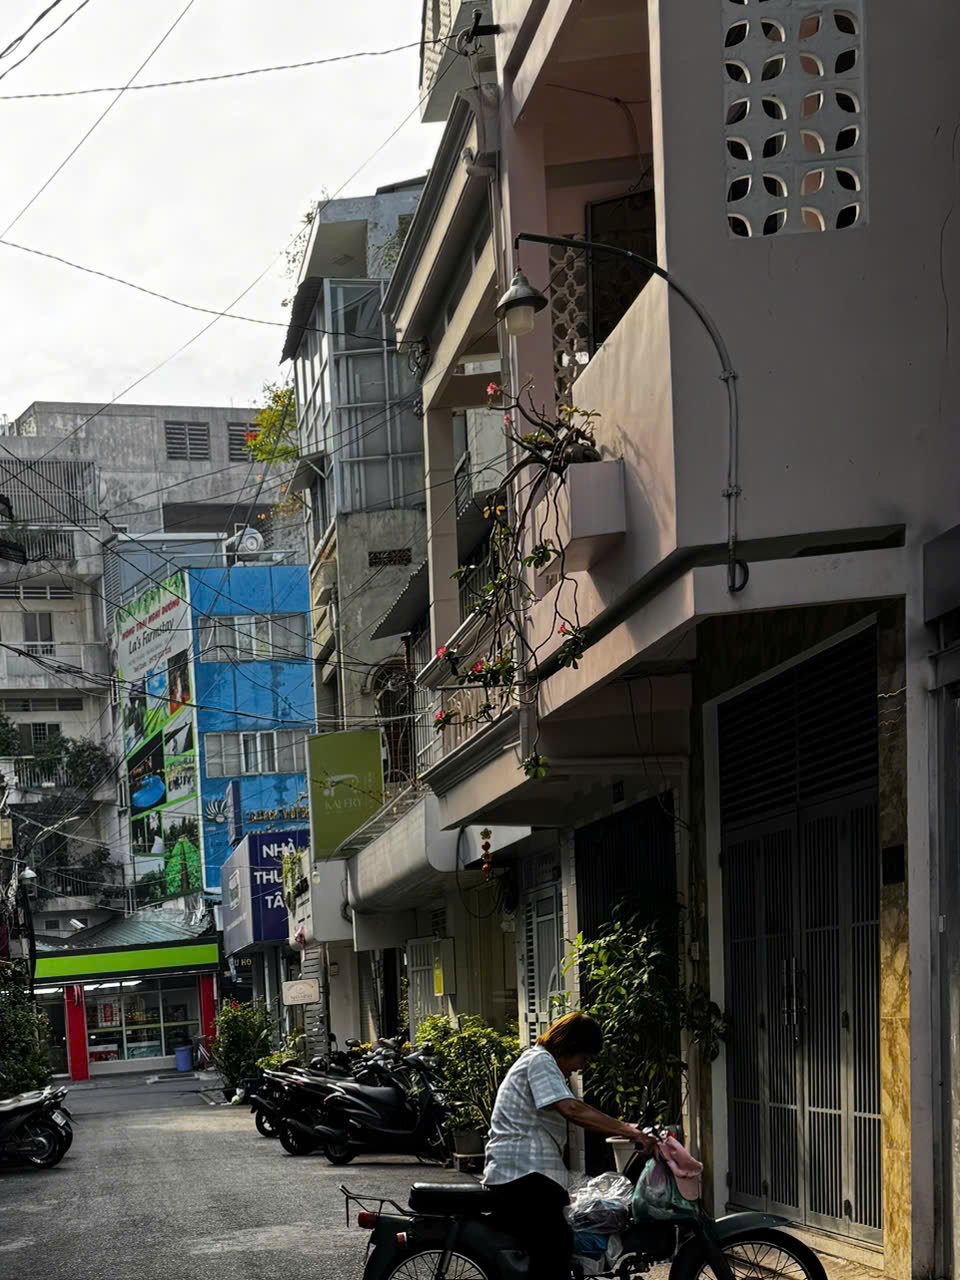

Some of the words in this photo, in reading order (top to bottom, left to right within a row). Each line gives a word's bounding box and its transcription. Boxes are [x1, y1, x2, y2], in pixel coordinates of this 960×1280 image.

[262, 838, 297, 859] NHÀ
[254, 872, 283, 885] THU
[265, 892, 285, 909] TÂ
